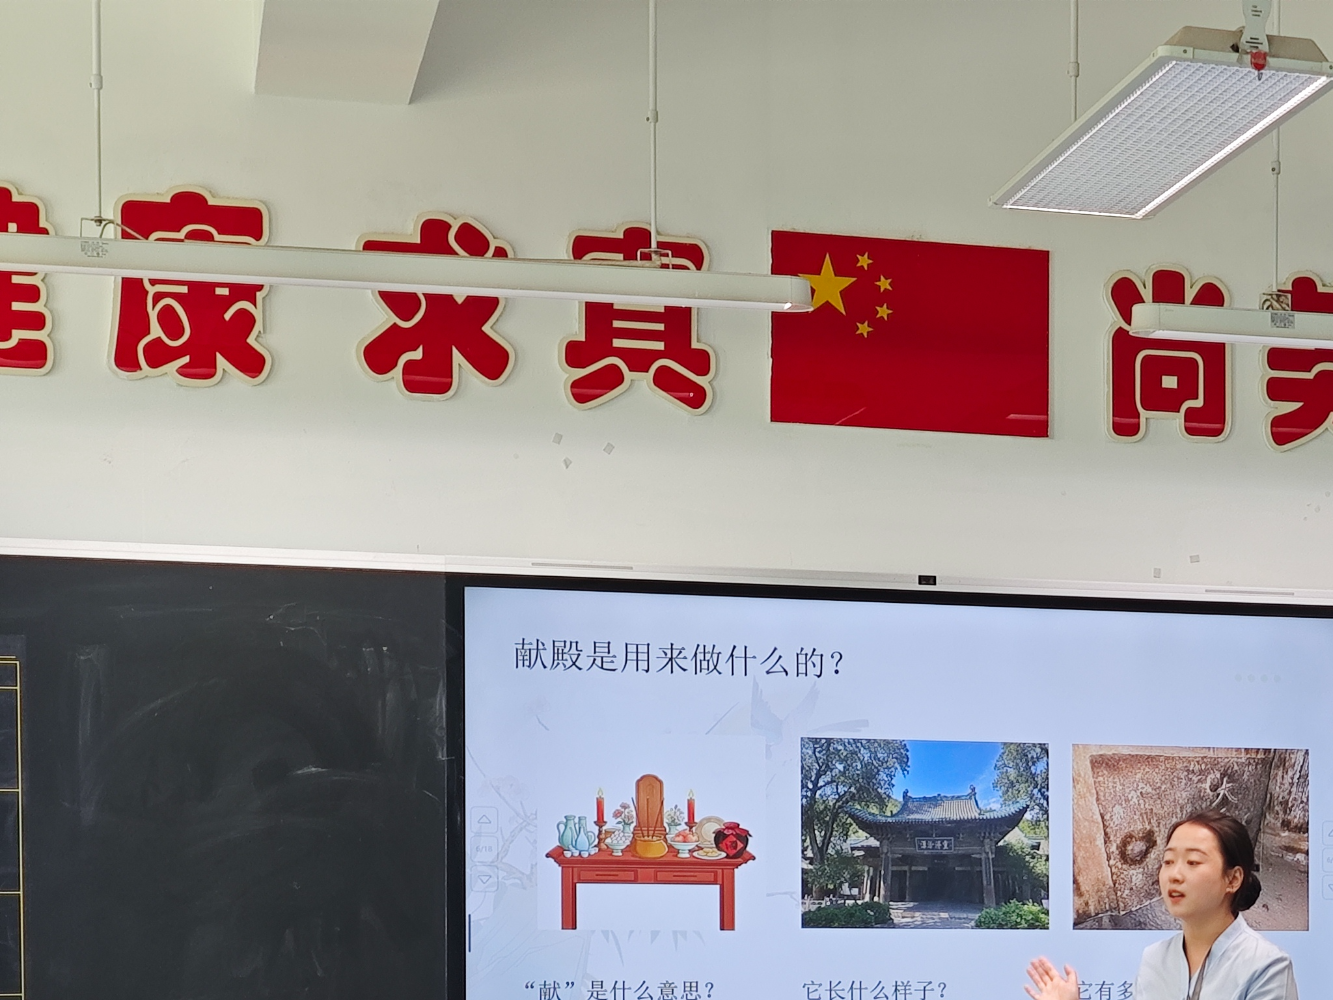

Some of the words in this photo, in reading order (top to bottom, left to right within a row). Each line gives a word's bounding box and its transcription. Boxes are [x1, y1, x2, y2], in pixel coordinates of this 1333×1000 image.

[513, 637, 845, 679] 献殿是用来做什么的？
